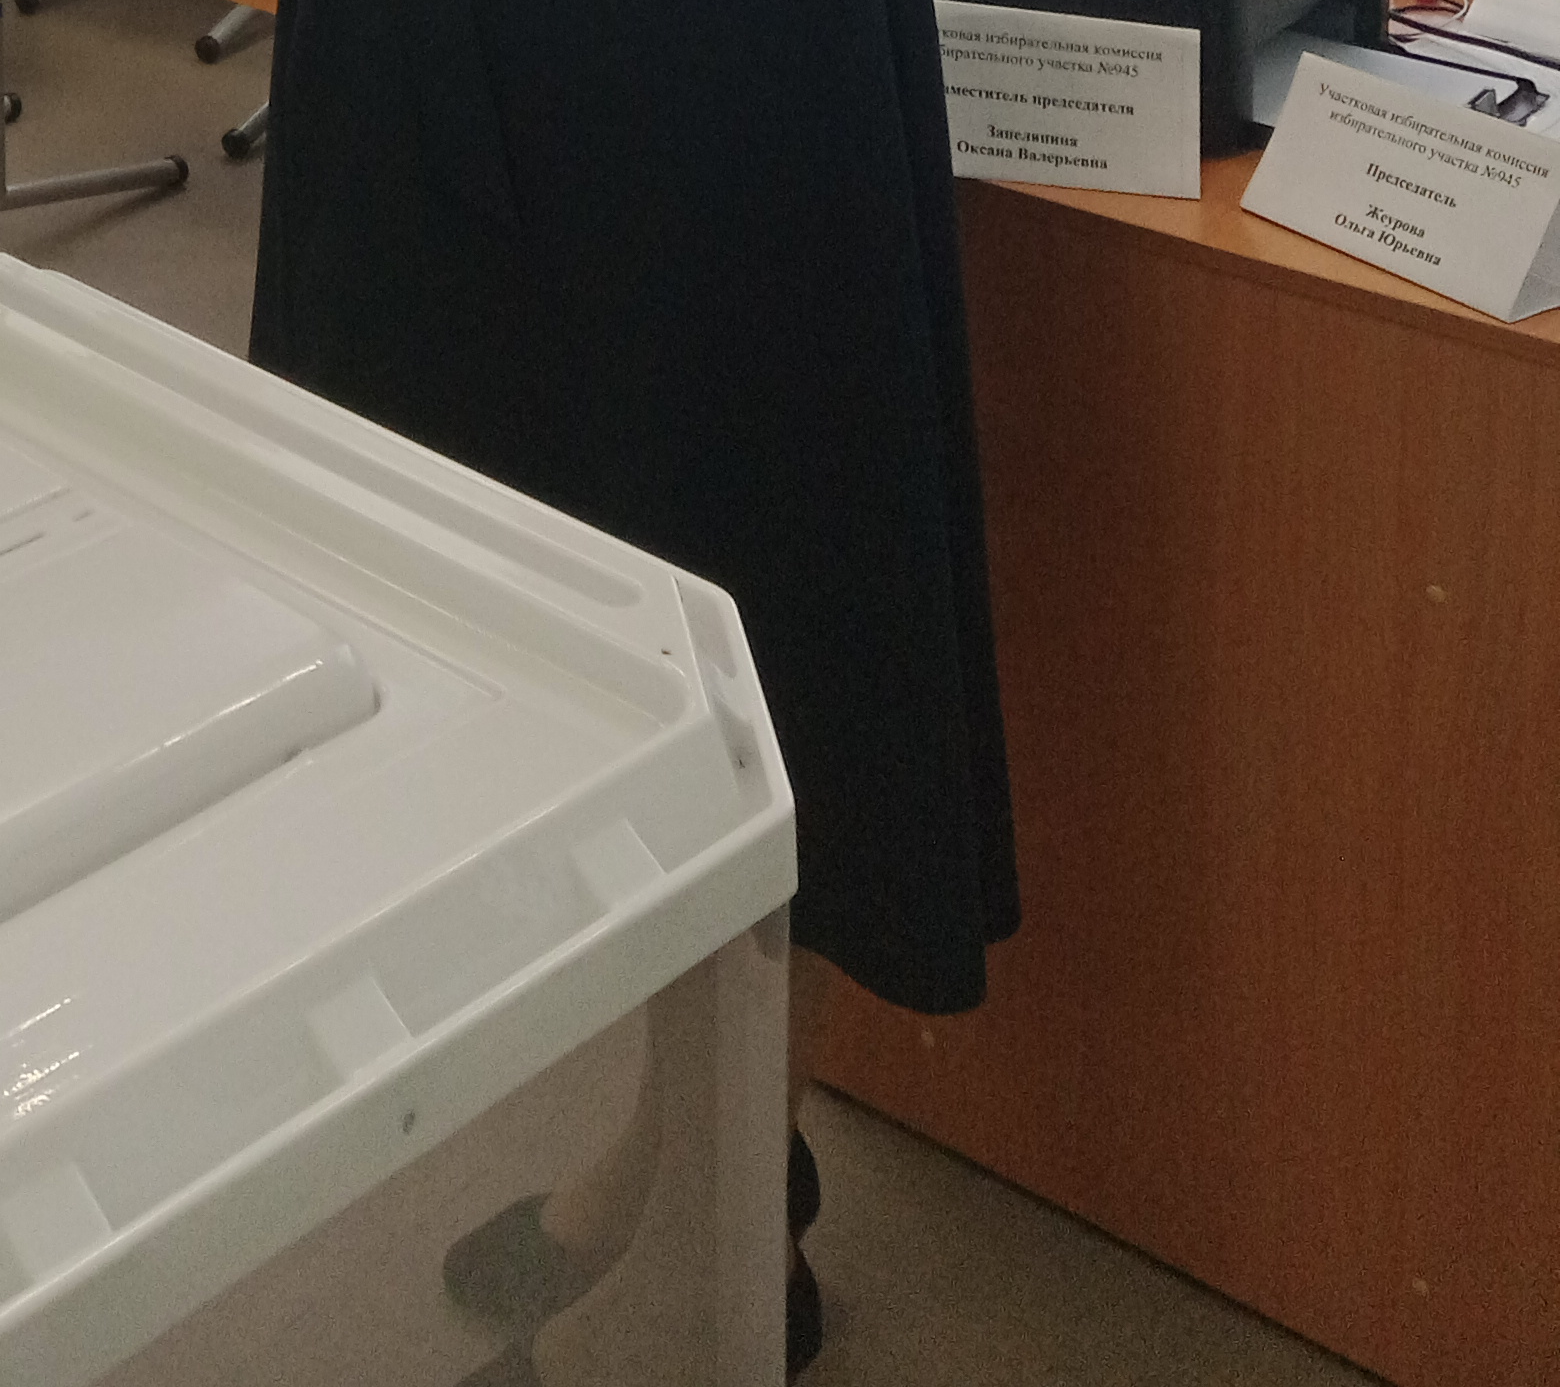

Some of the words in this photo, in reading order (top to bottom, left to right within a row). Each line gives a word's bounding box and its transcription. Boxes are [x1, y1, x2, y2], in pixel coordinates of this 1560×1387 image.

[985, 31, 1089, 54] избирательная
[1094, 45, 1163, 63] комиссия
[1037, 57, 1093, 74] участка
[1032, 94, 1134, 116] председателя
[1320, 82, 1388, 120] Участковая
[1390, 112, 1483, 154] избирательная
[1484, 148, 1549, 179] комиссия
[1329, 110, 1427, 155] избирательного
[1427, 147, 1479, 174] участка
[1480, 165, 1522, 189] №945
[957, 140, 1013, 159] Оксана
[1018, 148, 1108, 169] Валерьевна
[1366, 163, 1457, 208] Председатель
[1334, 213, 1376, 239] Ольга
[1377, 230, 1442, 266] Юрьевна
